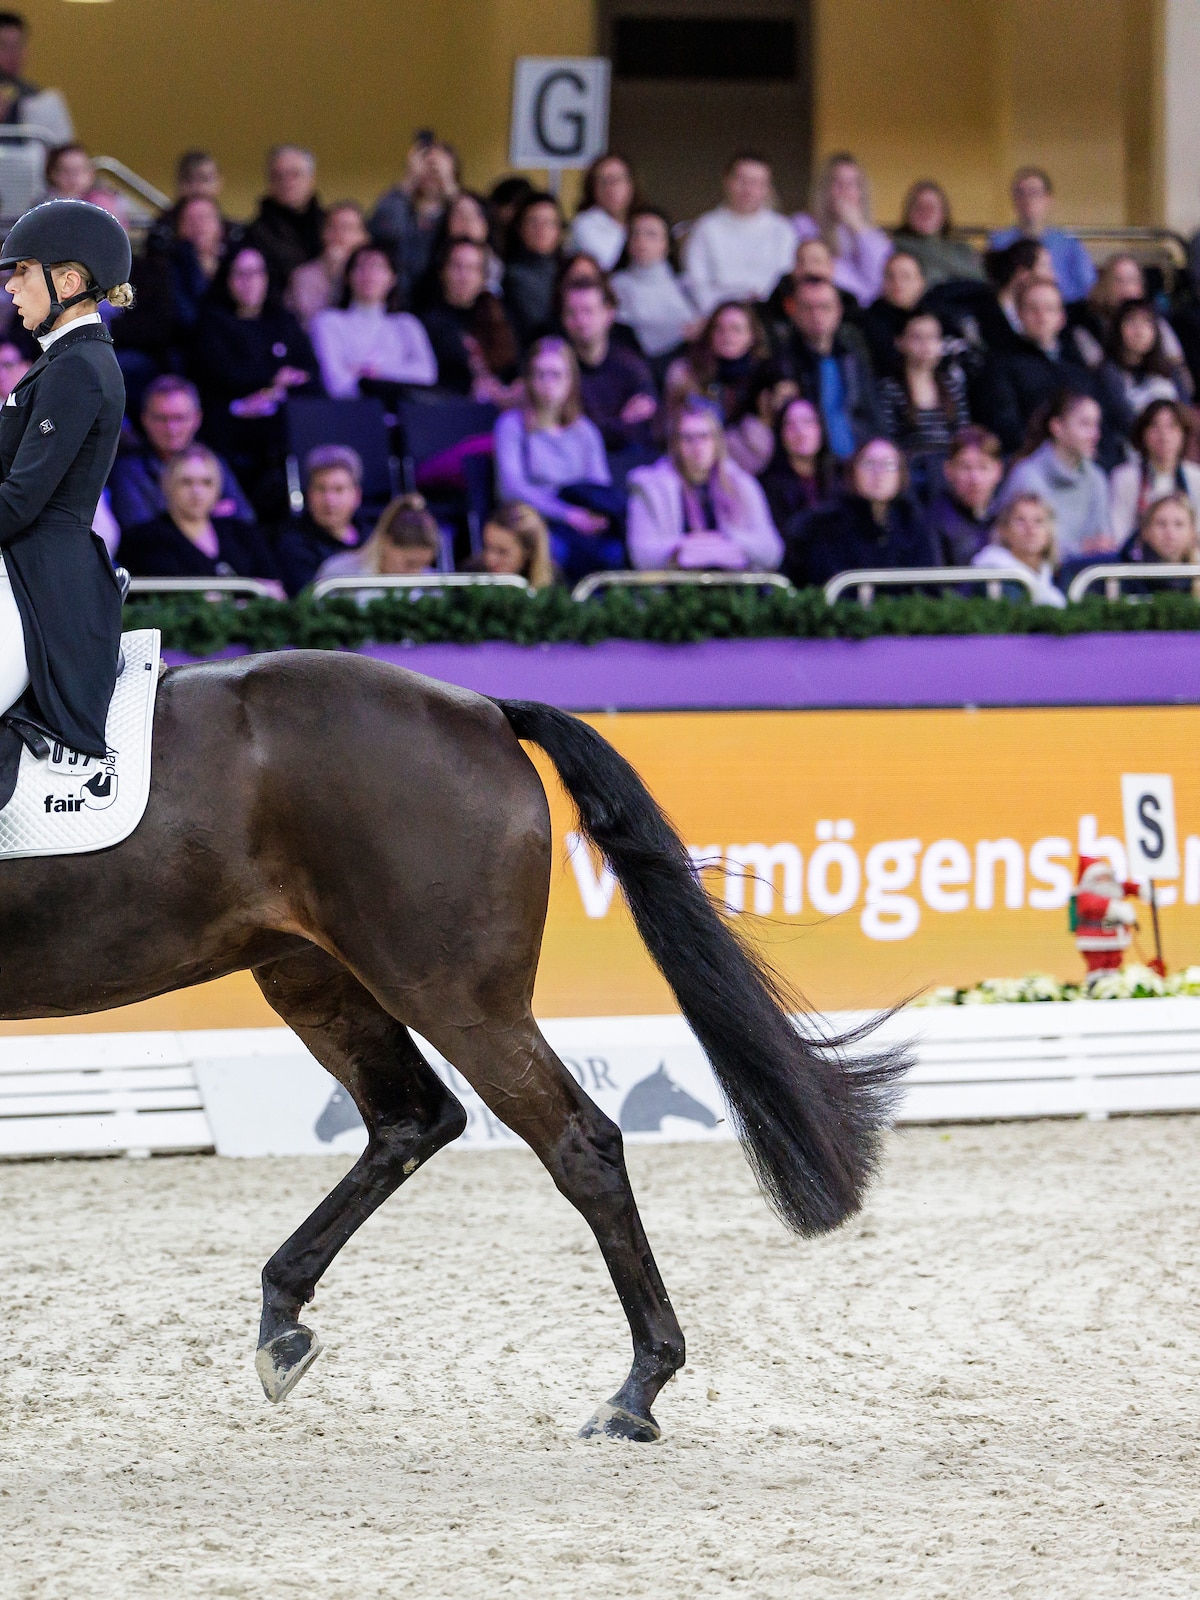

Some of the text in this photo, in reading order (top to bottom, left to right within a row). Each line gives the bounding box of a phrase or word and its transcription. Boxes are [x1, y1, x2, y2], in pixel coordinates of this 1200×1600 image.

[533, 68, 586, 157] G
[100, 745, 119, 777] play
[44, 793, 86, 813] fair
[1138, 793, 1165, 860] S
